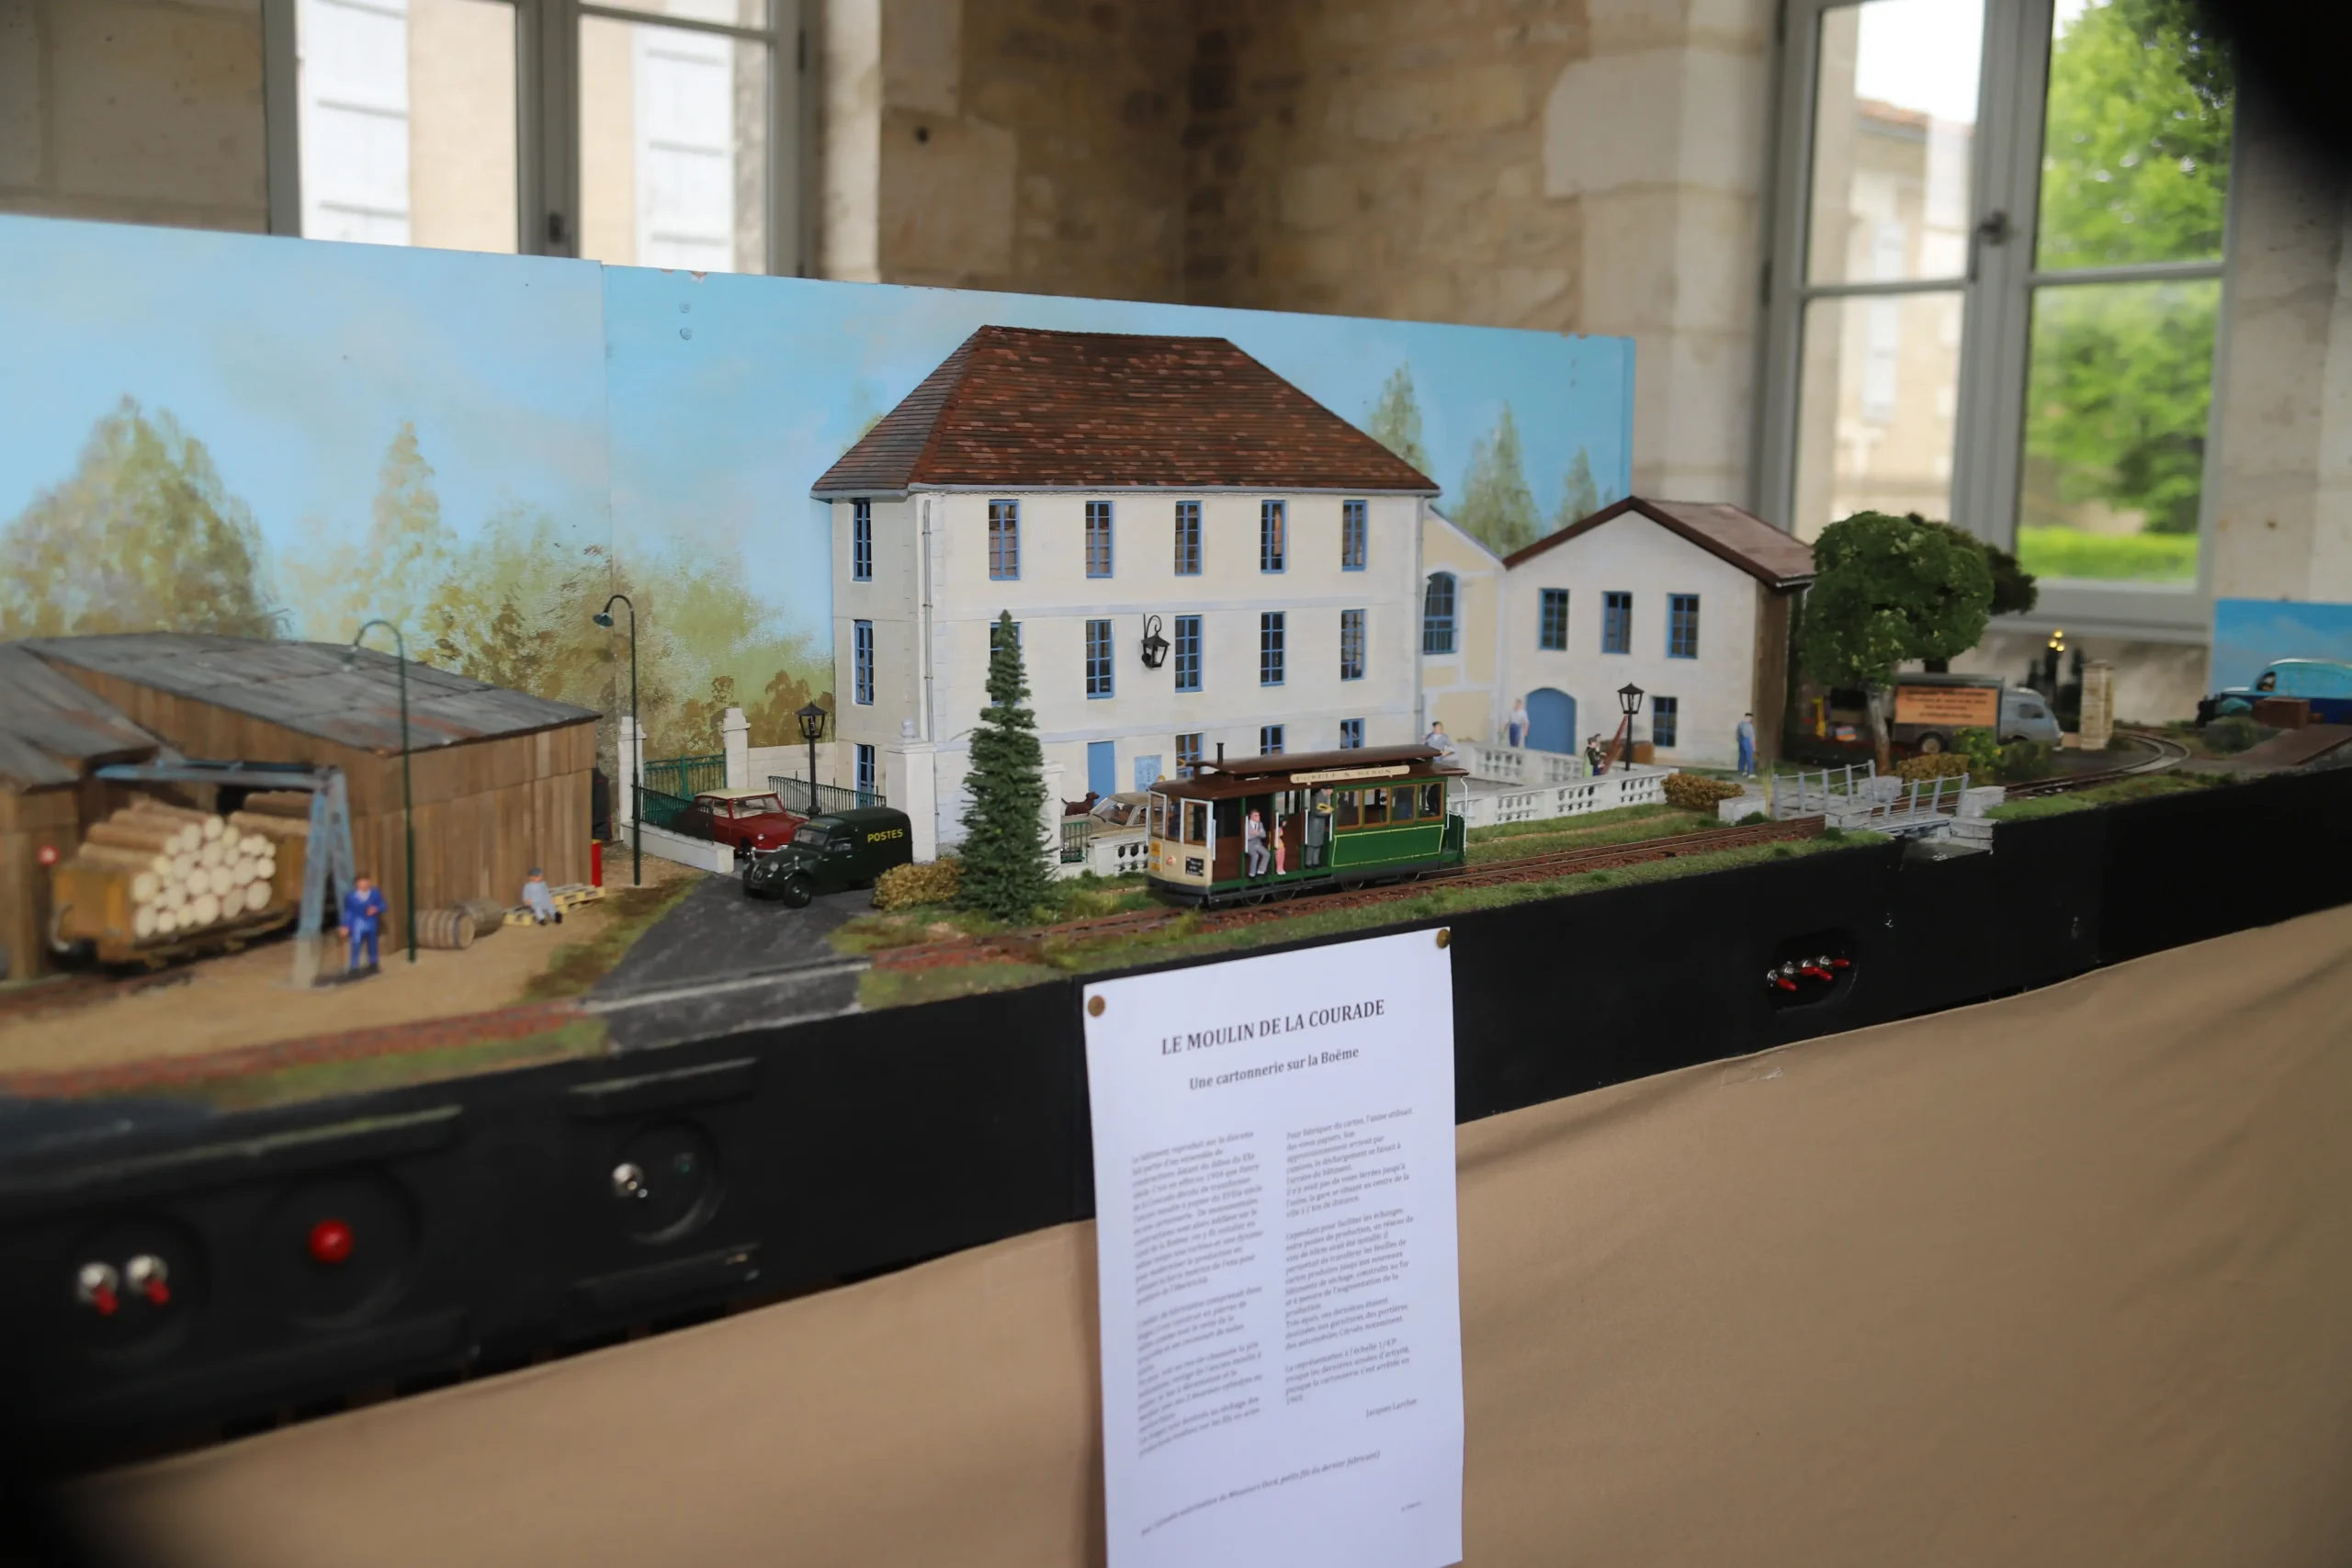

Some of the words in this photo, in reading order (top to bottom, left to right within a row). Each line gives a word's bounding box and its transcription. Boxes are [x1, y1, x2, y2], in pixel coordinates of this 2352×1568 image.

[866, 828, 904, 843] POSTES
[1161, 1035, 1182, 1055] LE
[1186, 1021, 1255, 1051] MOULIN
[1260, 1017, 1281, 1038] DE
[1285, 1012, 1305, 1033] LA
[1308, 998, 1385, 1028] COURADE
[1189, 1076, 1213, 1091] Une
[1216, 1062, 1284, 1086] cartonnerie
[1286, 1058, 1306, 1072] sur
[1307, 1054, 1318, 1067] la
